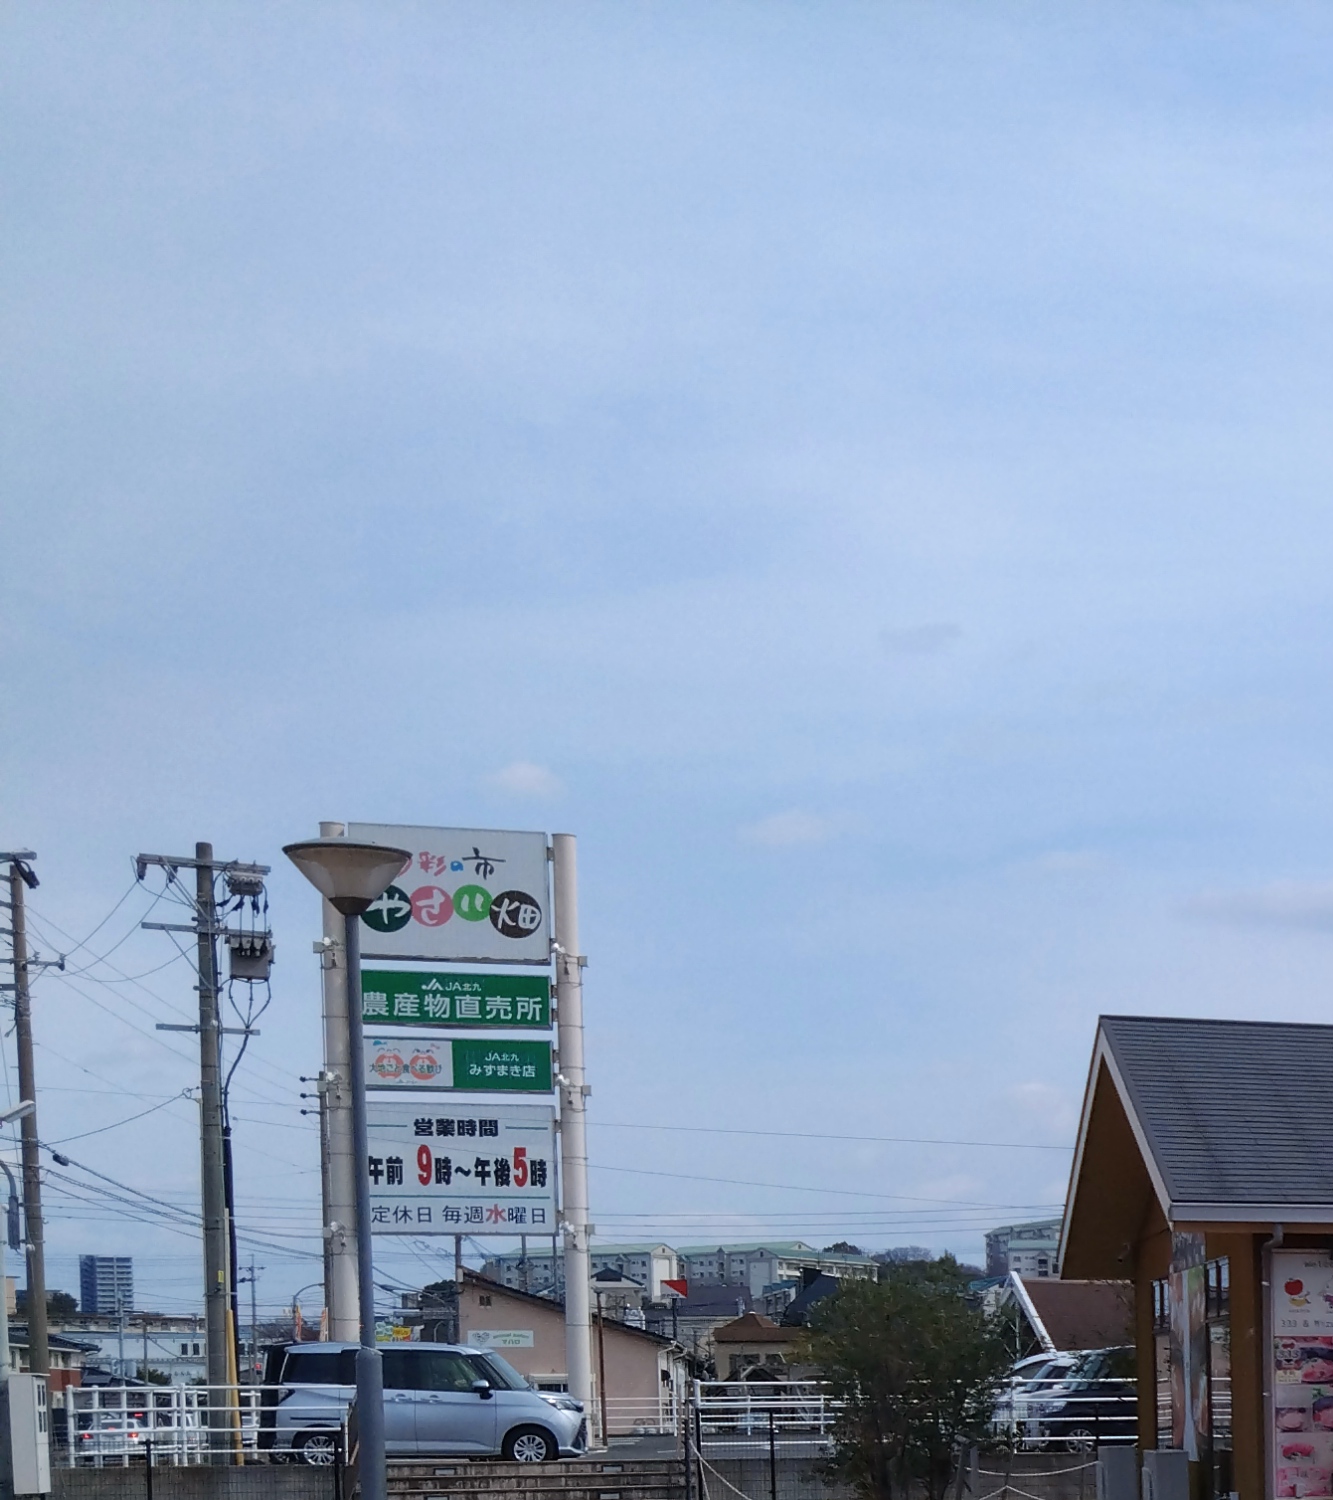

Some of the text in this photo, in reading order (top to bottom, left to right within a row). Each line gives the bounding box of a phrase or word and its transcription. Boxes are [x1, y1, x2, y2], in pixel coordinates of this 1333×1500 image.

[398, 846, 507, 880] 彩の市
[366, 886, 542, 932] やさい畑
[445, 981, 482, 992] JA北九
[362, 991, 543, 1022] 農産物直売所
[485, 1052, 520, 1062] JA北九
[469, 1063, 536, 1078] みずまき店
[413, 1117, 499, 1138] 営業時間
[368, 1154, 404, 1186] 午前
[371, 1203, 546, 1225] 定休日 毎週水曜日
